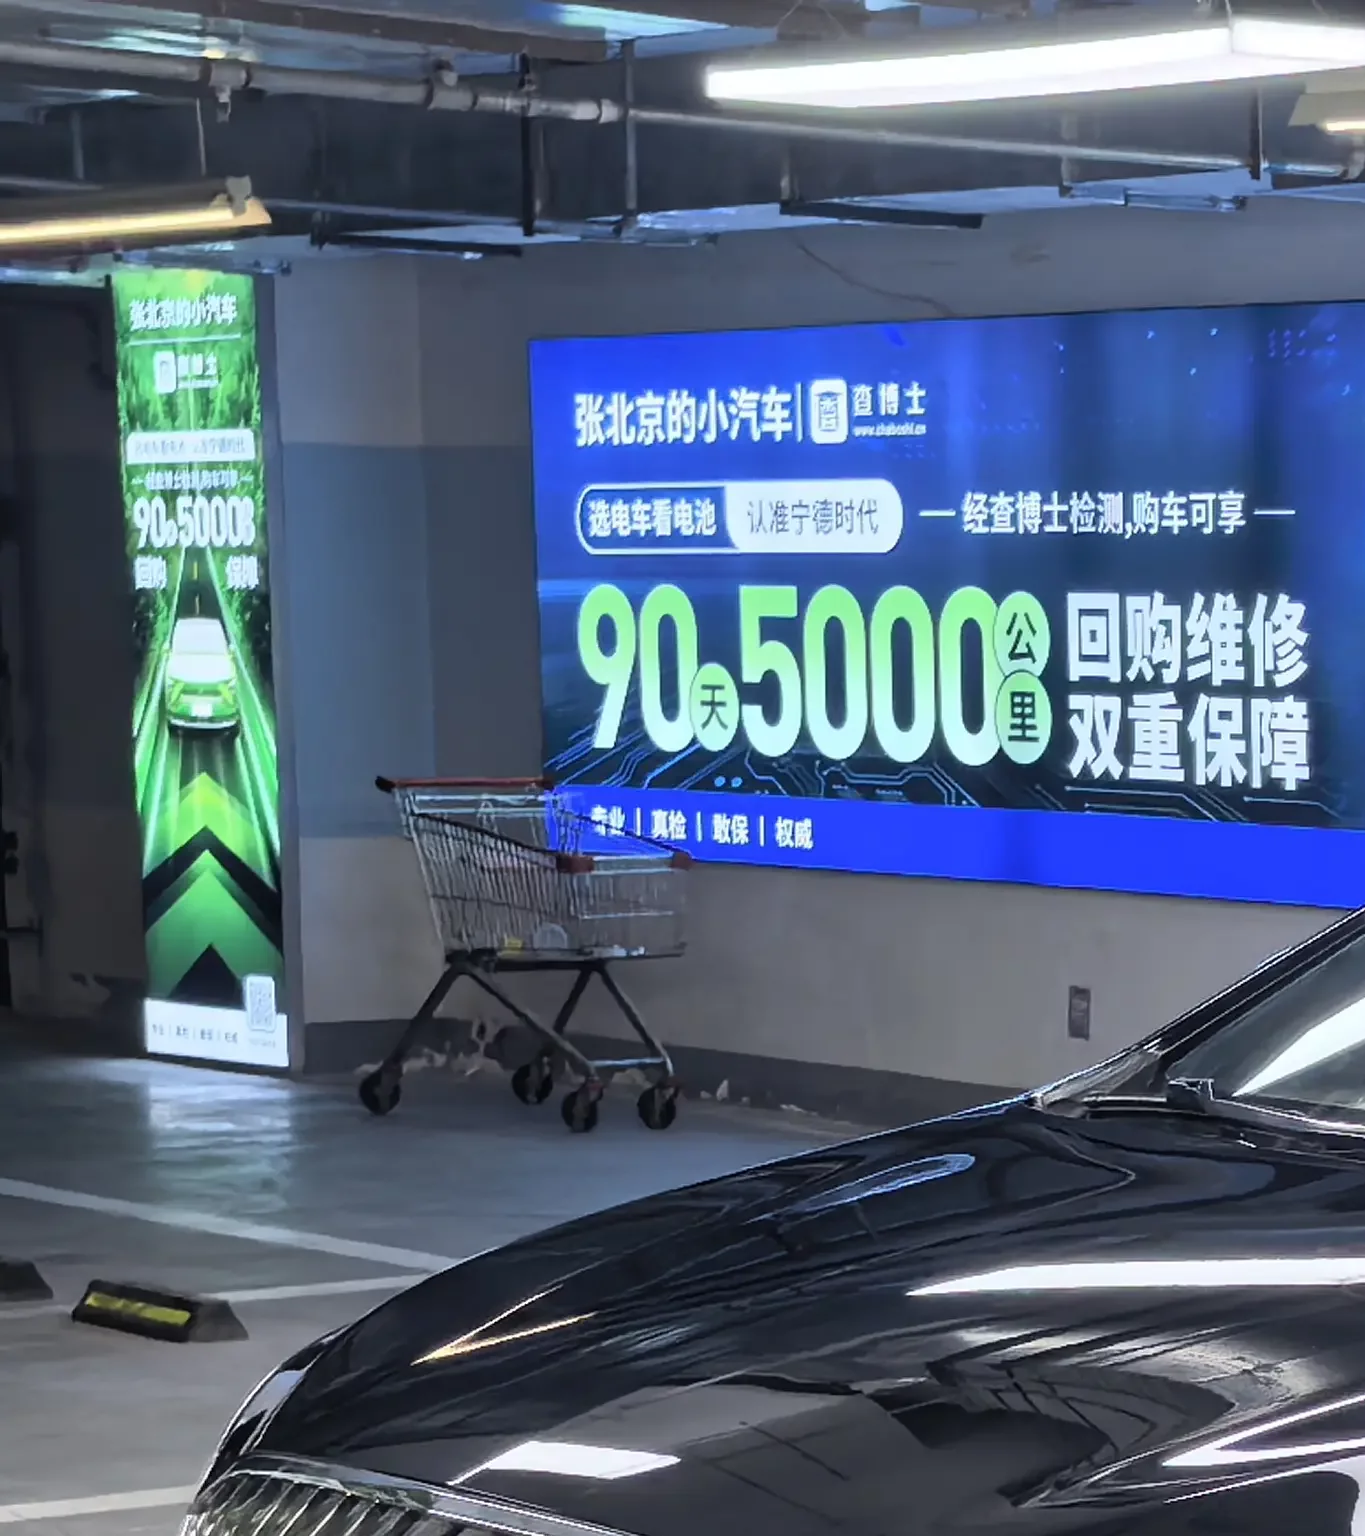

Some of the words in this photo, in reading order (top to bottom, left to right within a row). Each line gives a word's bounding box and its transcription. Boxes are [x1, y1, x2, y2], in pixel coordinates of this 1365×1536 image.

[574, 386, 793, 447] 张北京的小汽车
[853, 381, 927, 416] 查博士
[588, 498, 717, 537] 选电车看电池
[747, 498, 879, 536] 认准宁德时代
[1066, 591, 1309, 688] 回购维修
[1066, 690, 1311, 791] 双重保障
[652, 809, 688, 841] 真检
[712, 812, 749, 845] 敢保
[774, 816, 814, 850] 权威
